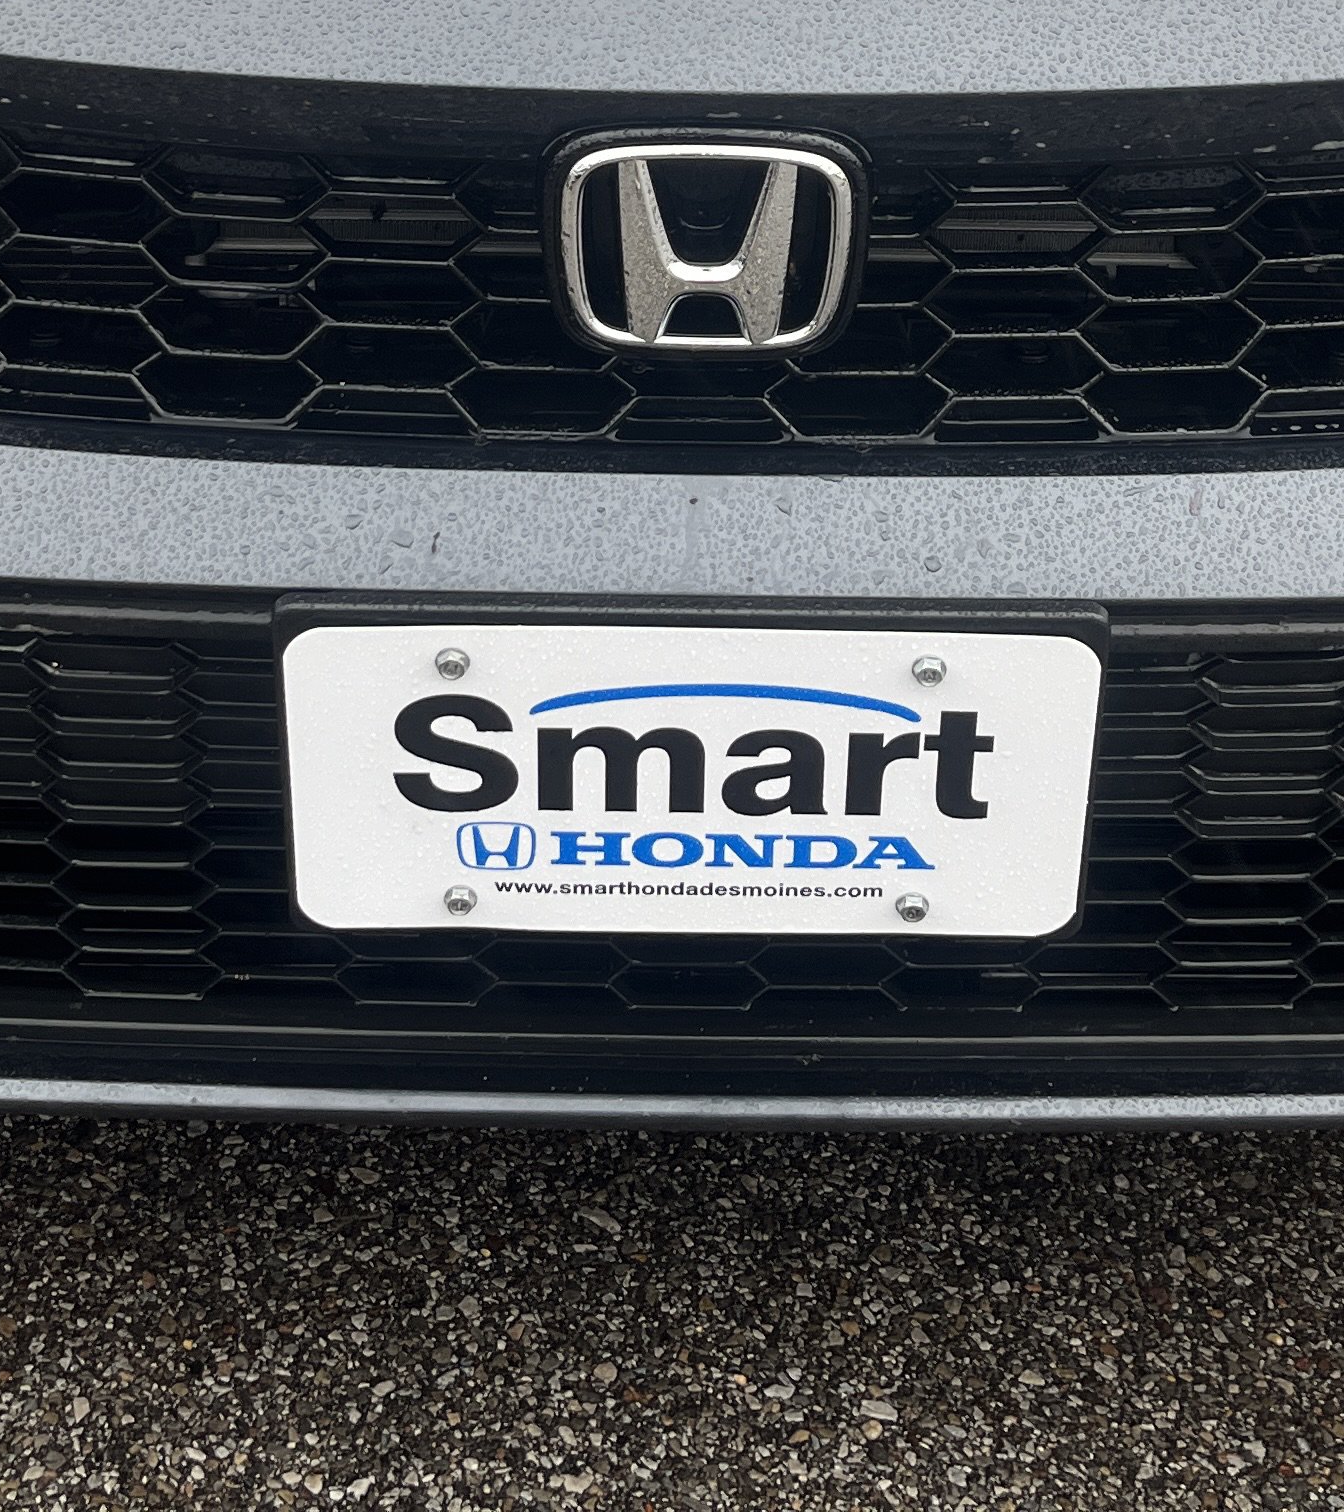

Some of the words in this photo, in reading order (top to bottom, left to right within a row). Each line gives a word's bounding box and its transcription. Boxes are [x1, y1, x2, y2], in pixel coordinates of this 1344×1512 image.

[392, 694, 995, 820] Smart
[550, 830, 936, 872] HONDA
[494, 880, 884, 899] www.smarthondadesmoines.com
